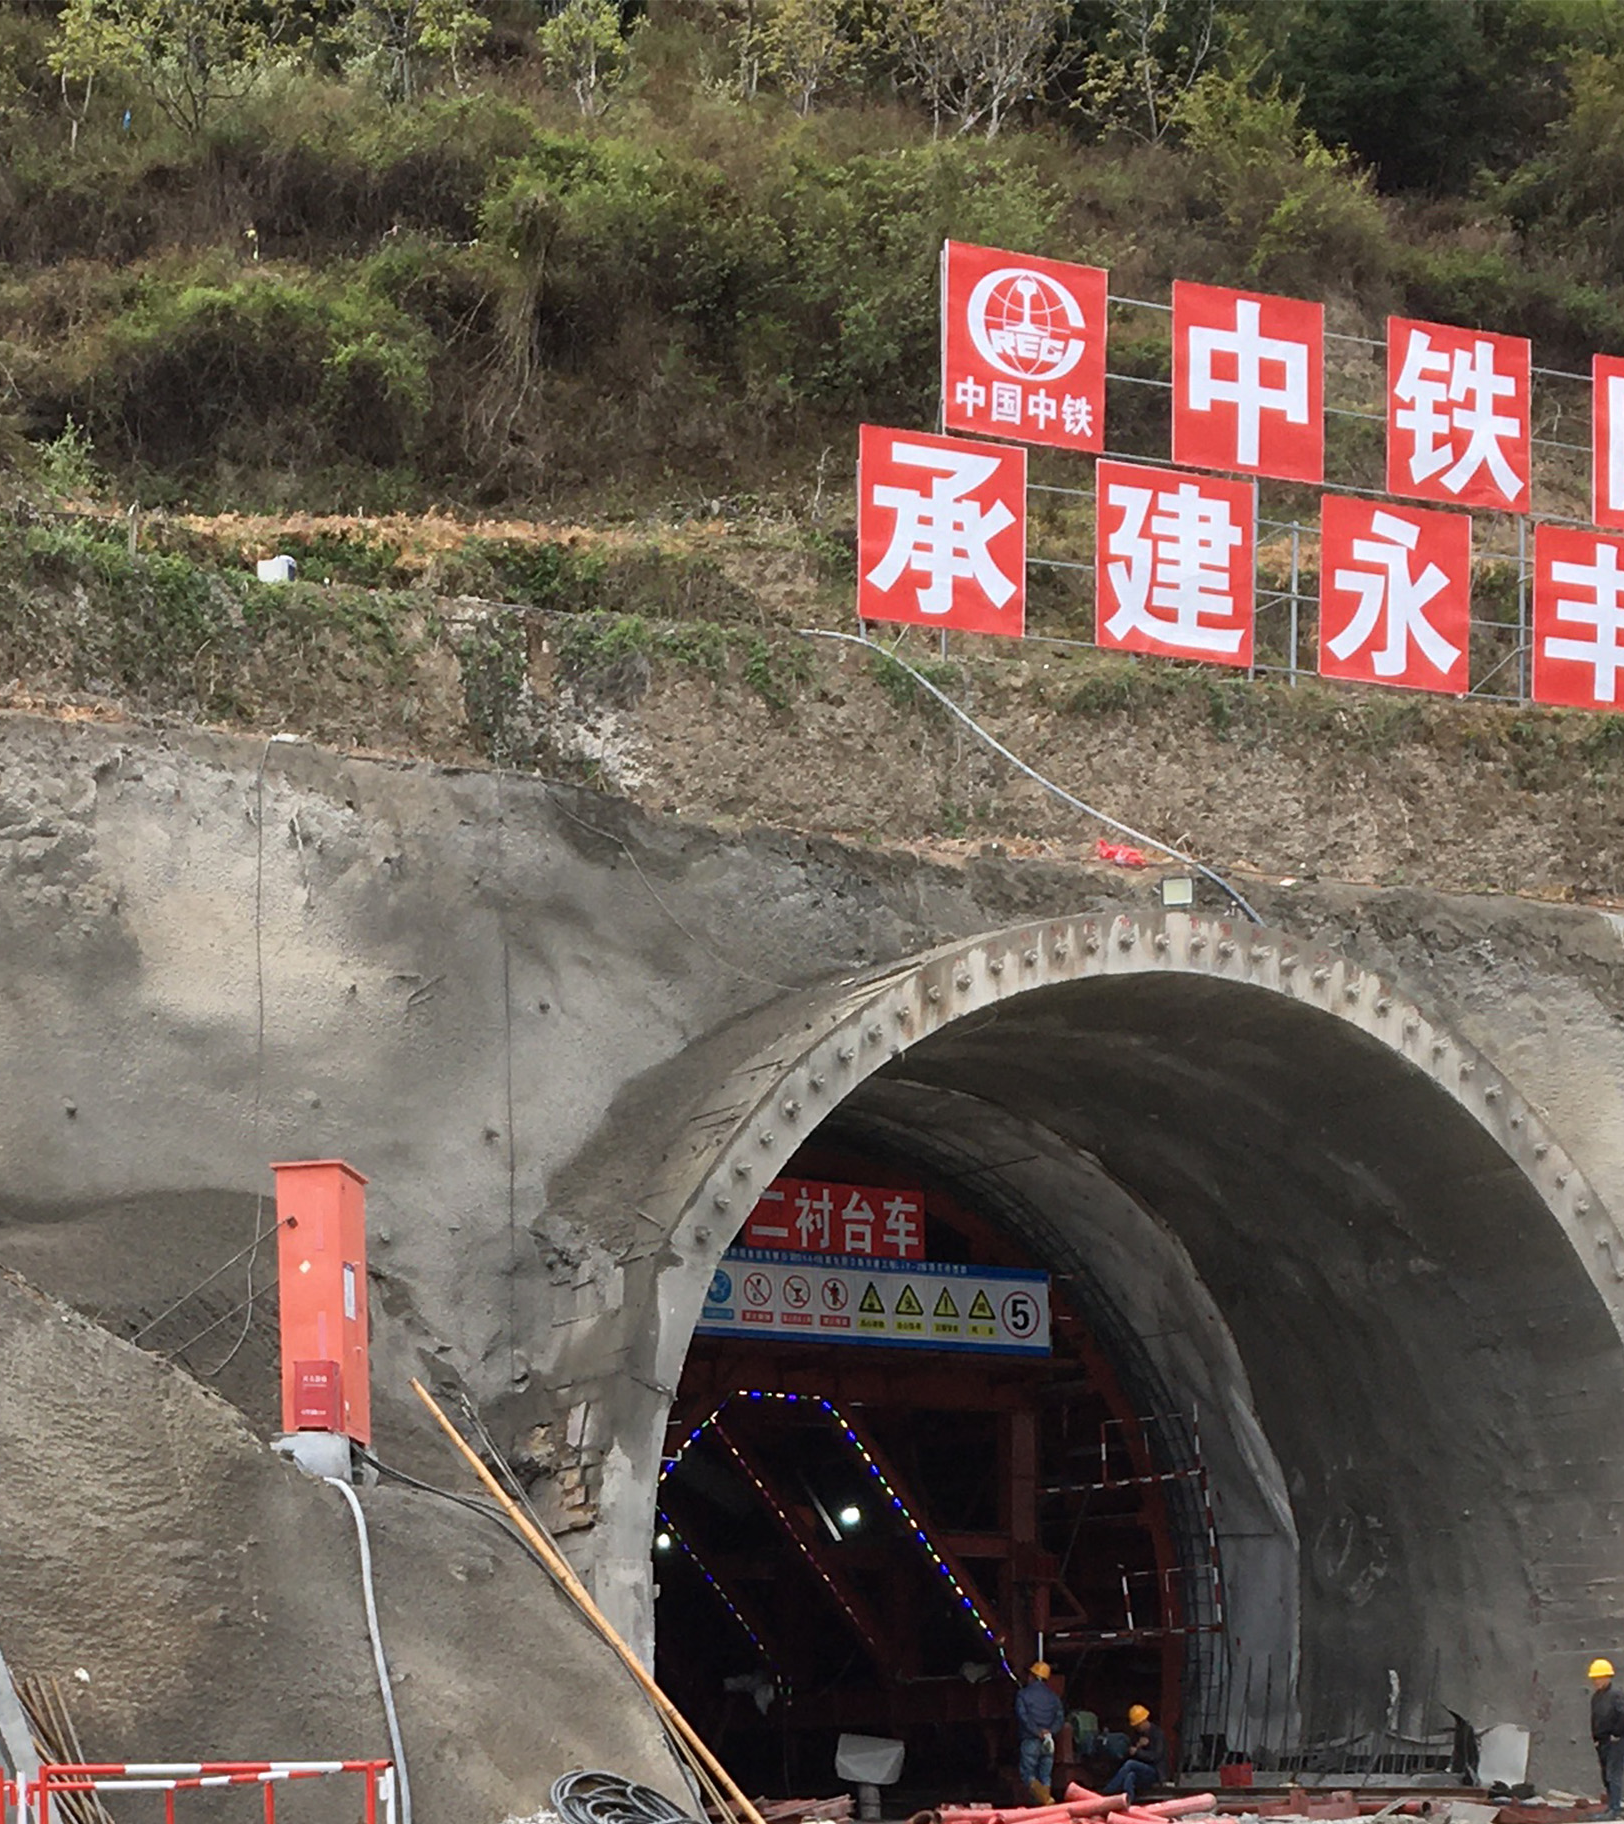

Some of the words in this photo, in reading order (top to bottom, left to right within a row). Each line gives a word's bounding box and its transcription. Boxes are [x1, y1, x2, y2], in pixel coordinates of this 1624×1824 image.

[955, 376, 1093, 437] 中国中铁
[751, 1187, 919, 1256] 二衬台车
[1011, 1299, 1030, 1330] 5
